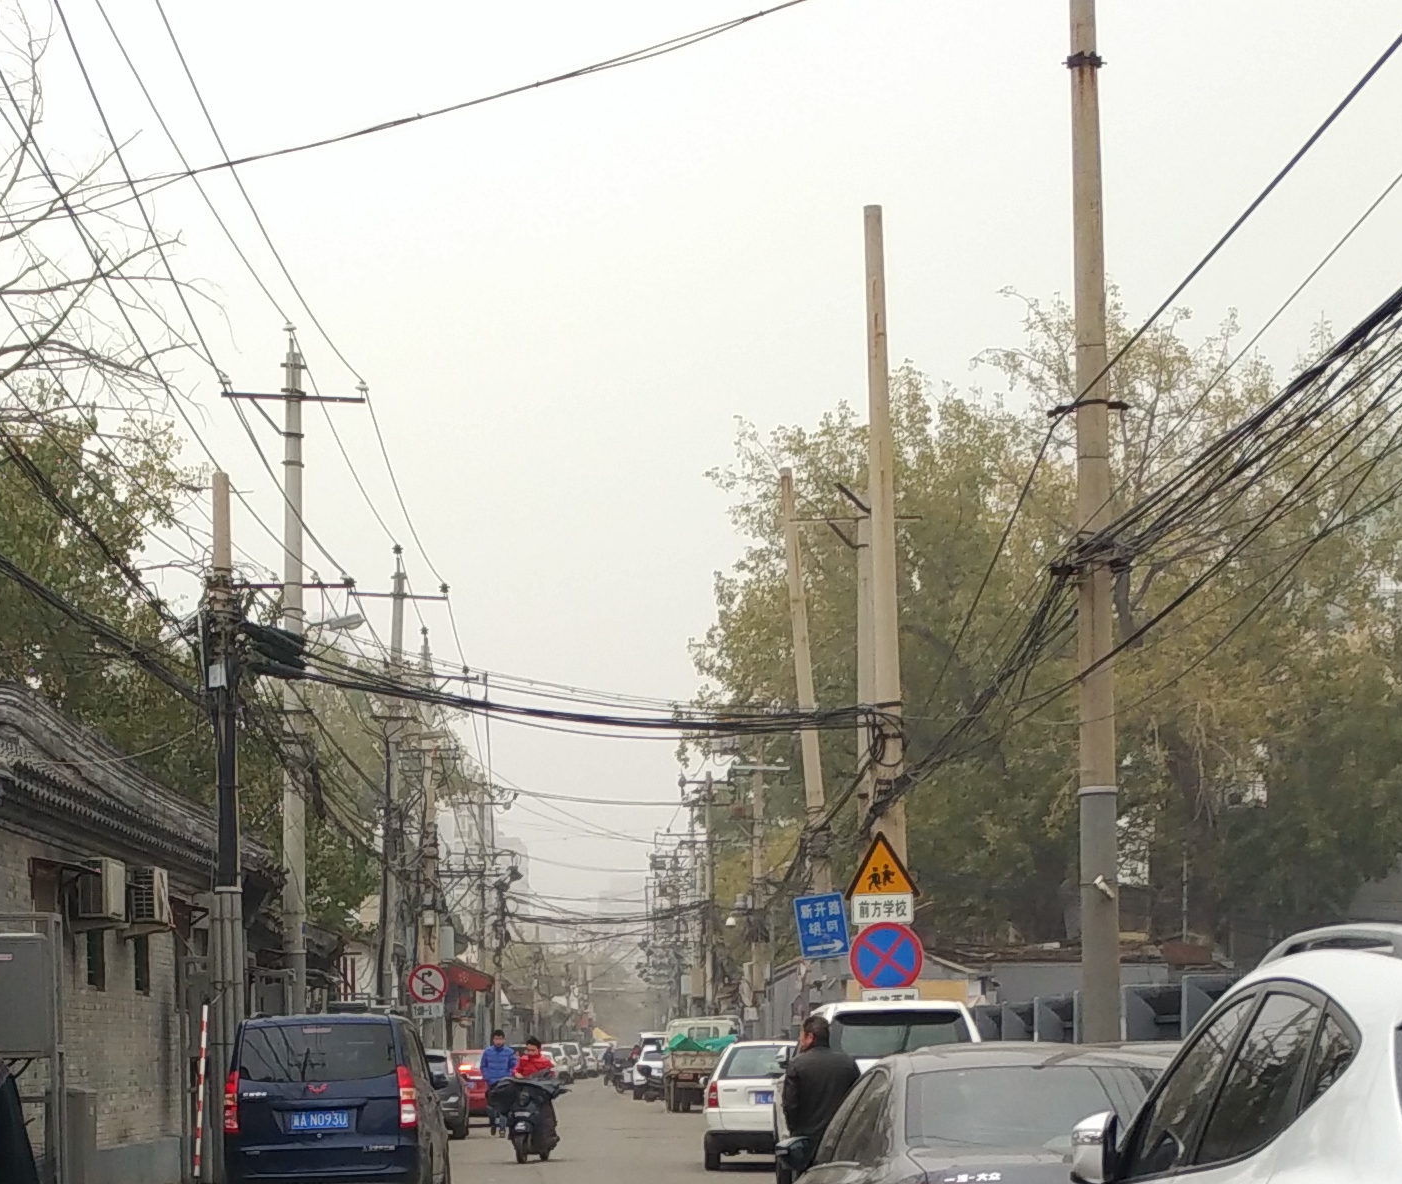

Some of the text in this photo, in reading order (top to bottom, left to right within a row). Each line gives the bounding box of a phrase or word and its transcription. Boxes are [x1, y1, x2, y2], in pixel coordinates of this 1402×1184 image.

[800, 901, 840, 919] 新开路
[858, 899, 908, 919] 前方学校
[808, 919, 839, 937] 胡同
